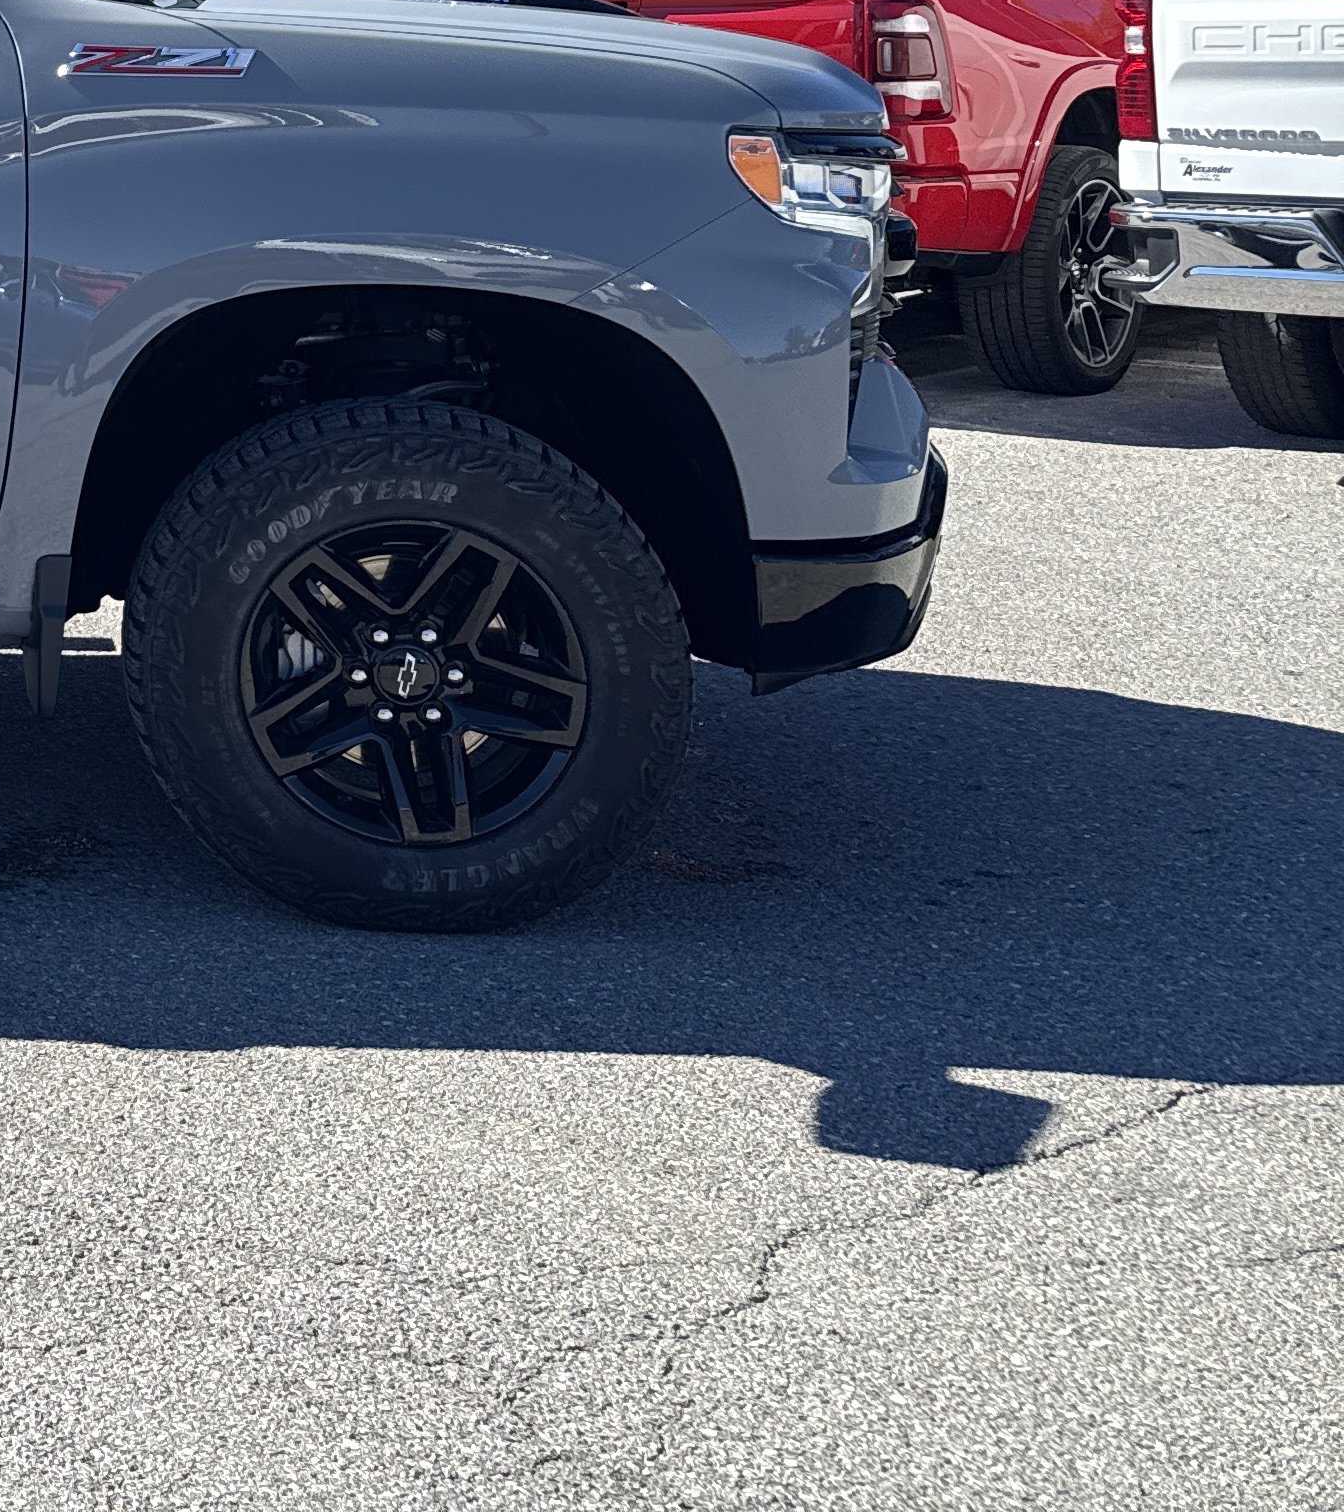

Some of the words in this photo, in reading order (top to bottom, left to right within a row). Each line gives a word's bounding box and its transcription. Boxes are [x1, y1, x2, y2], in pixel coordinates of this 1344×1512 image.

[57, 42, 260, 78] Z71
[1166, 127, 1322, 141] SILVERADO
[1182, 163, 1234, 177] Alexander
[227, 478, 460, 586] GOODYEAR
